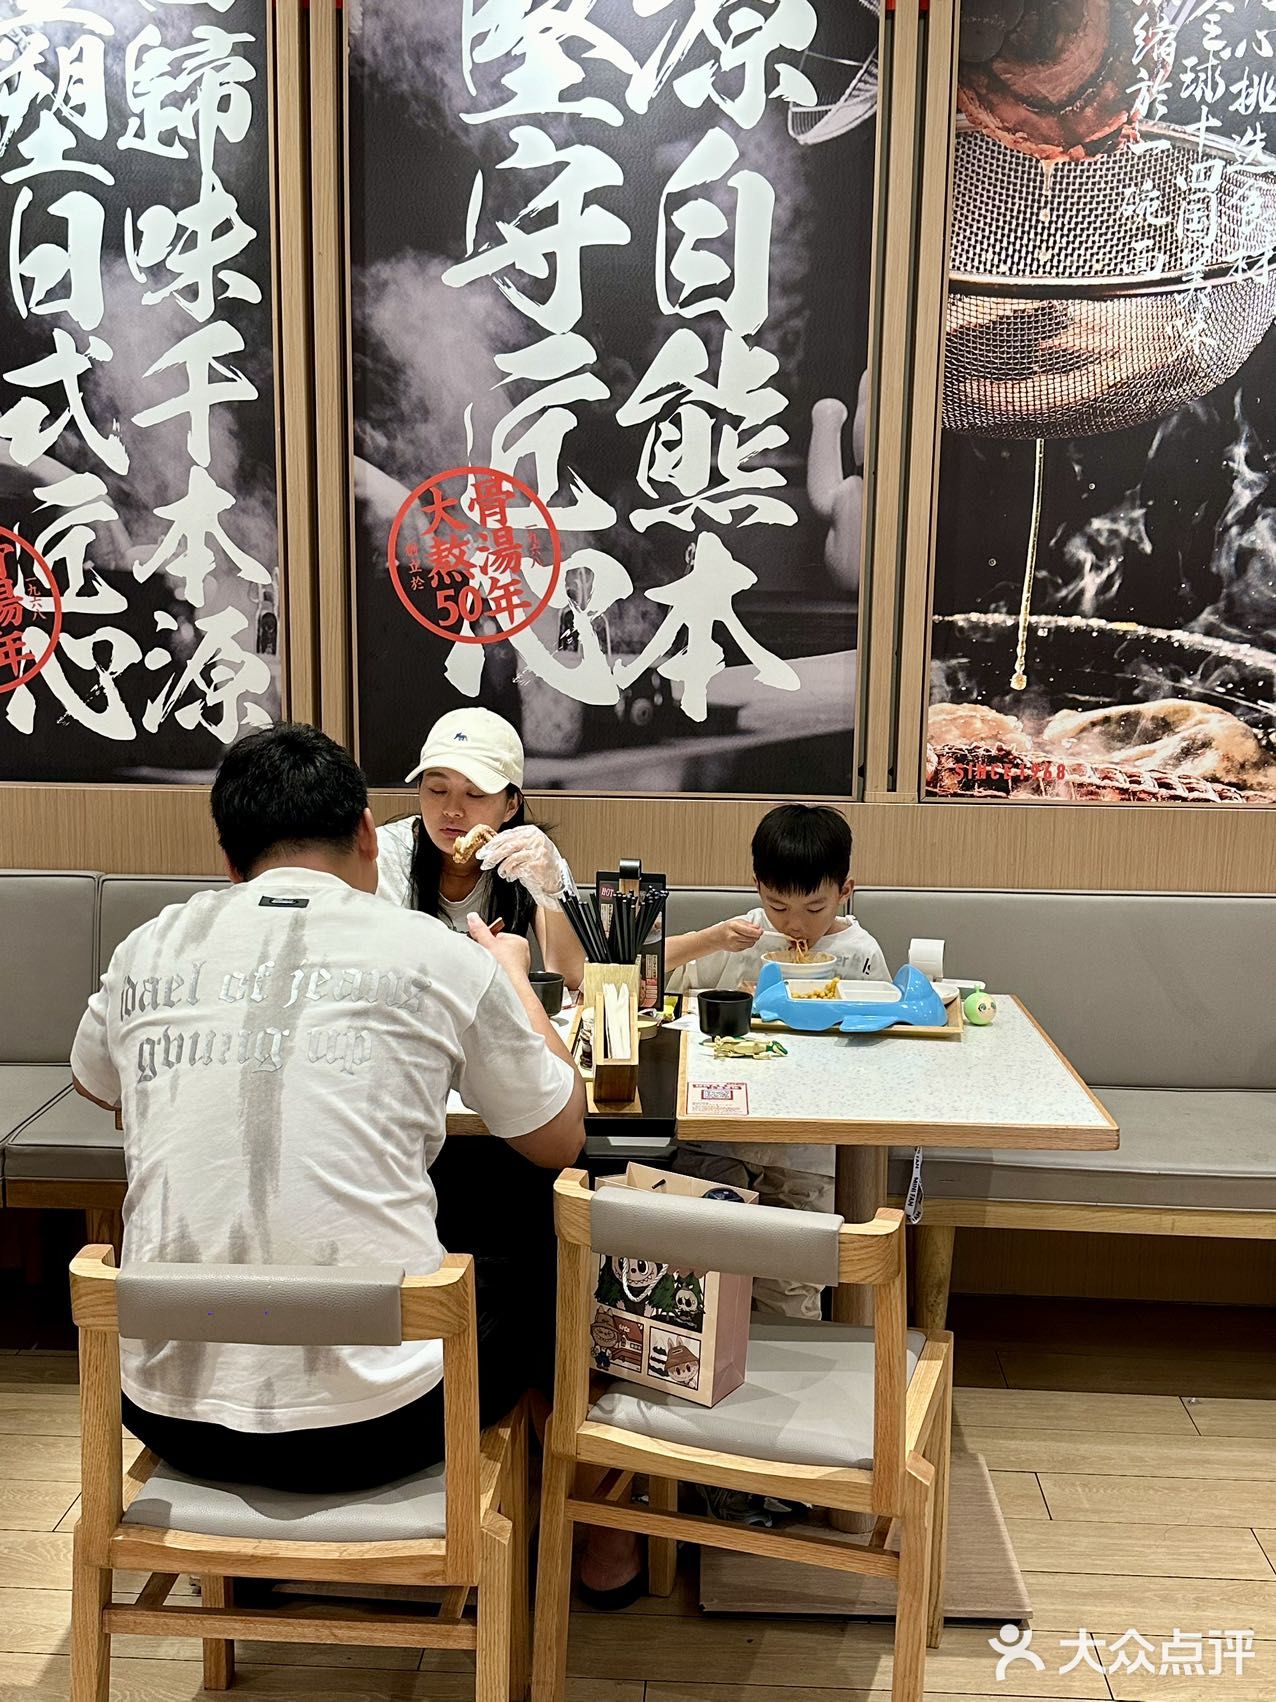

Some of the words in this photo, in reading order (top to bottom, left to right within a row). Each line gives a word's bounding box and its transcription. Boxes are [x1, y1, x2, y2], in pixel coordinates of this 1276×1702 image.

[0, 0, 142, 740] 塑日式匠心
[117, 0, 272, 743] 歸味千本源
[24, 576, 47, 622] 一九六八
[954, 763, 1012, 780] SINCE
[1020, 763, 1067, 780] 1968
[907, 1193, 917, 1207] FAN
[911, 1176, 919, 1193] MINI
